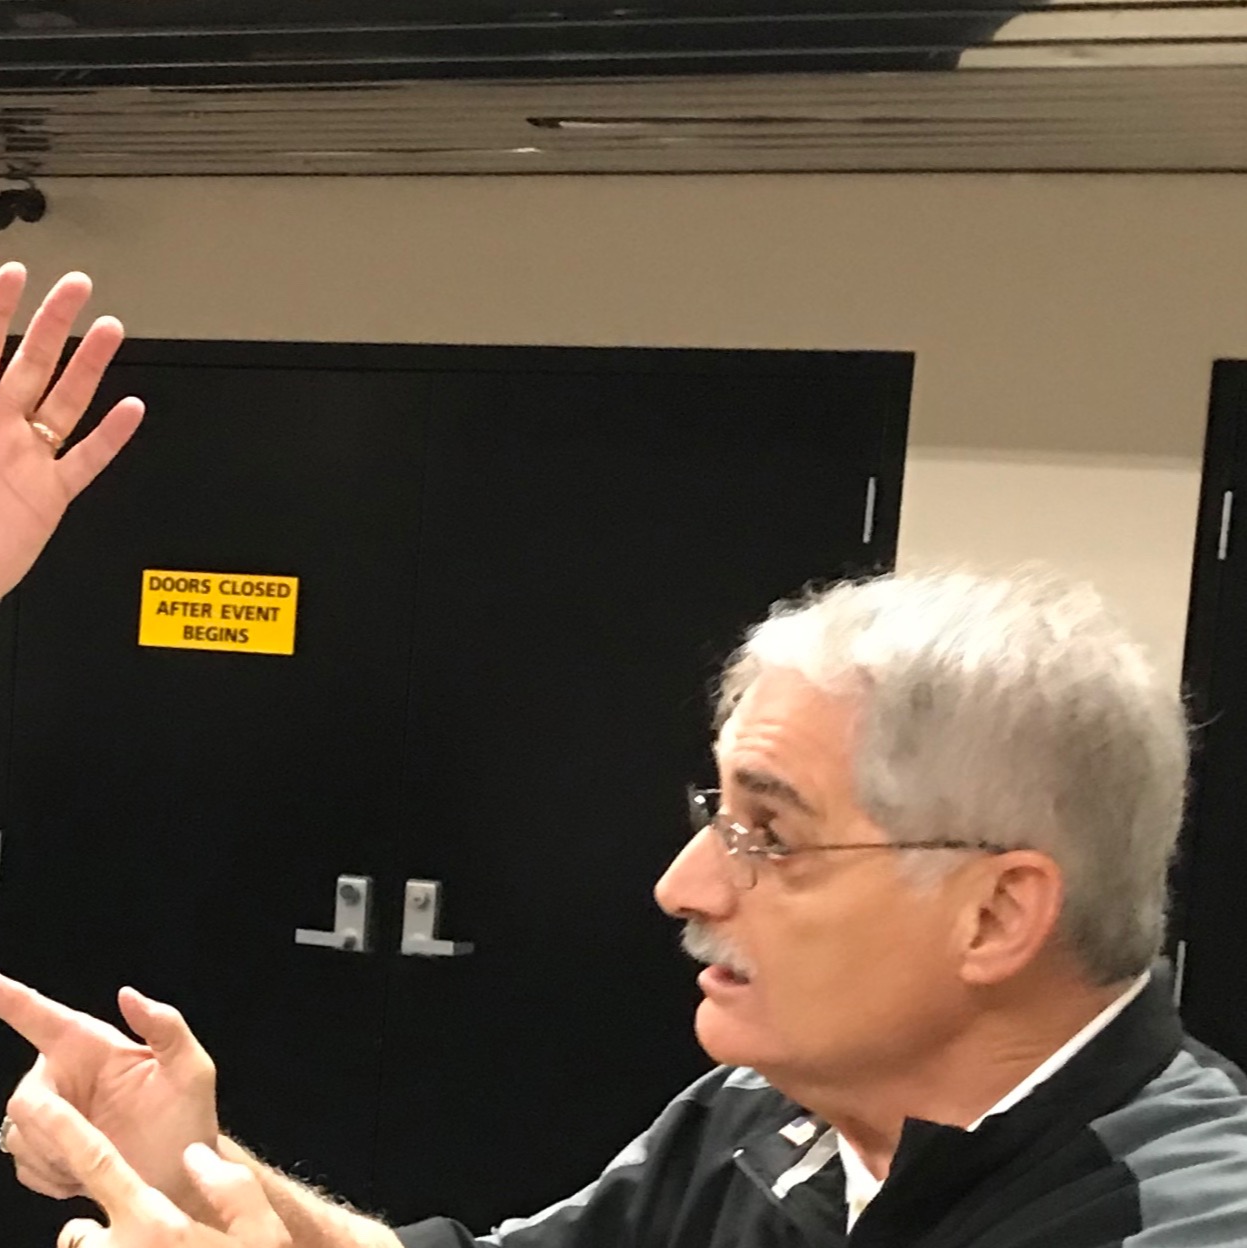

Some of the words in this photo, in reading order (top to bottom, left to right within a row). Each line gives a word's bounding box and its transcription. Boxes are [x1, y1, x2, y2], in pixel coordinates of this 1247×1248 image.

[149, 576, 211, 594] DOORS
[218, 580, 291, 598] CLOSED
[156, 601, 212, 618] AFTER
[221, 604, 280, 622] EVENT
[183, 625, 249, 643] BEGINS
